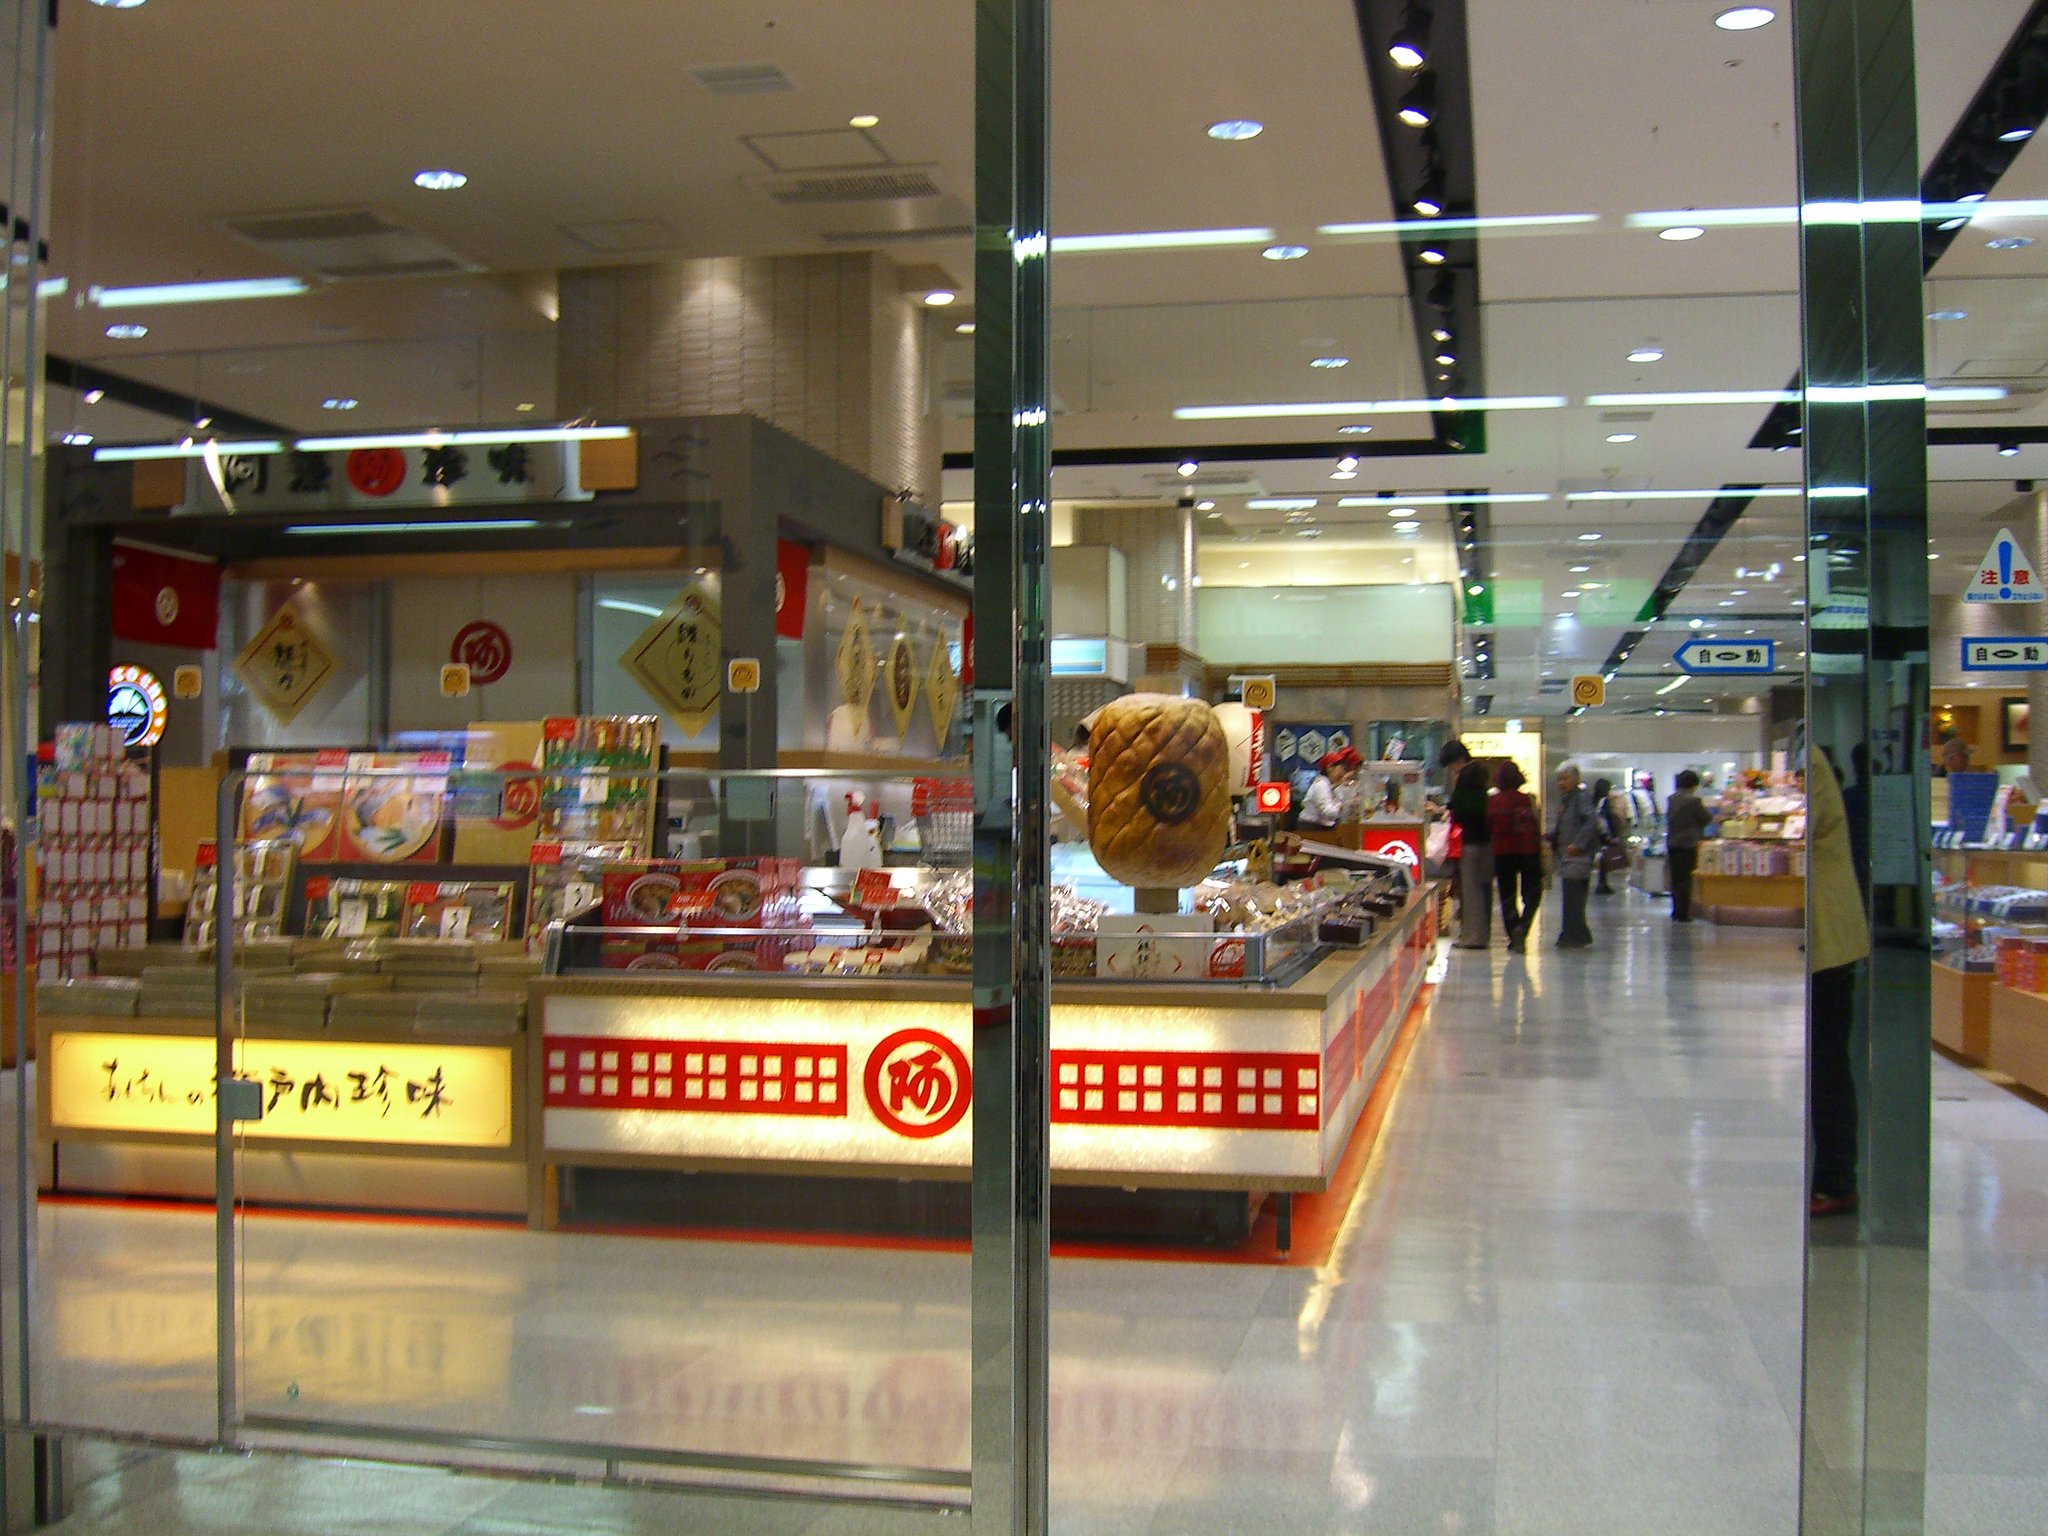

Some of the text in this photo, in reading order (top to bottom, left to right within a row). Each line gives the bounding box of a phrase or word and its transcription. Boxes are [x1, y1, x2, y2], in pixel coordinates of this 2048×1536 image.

[1981, 569, 2030, 585] 注意
[1699, 648, 1761, 664] 自動
[1976, 647, 2039, 661] 自動
